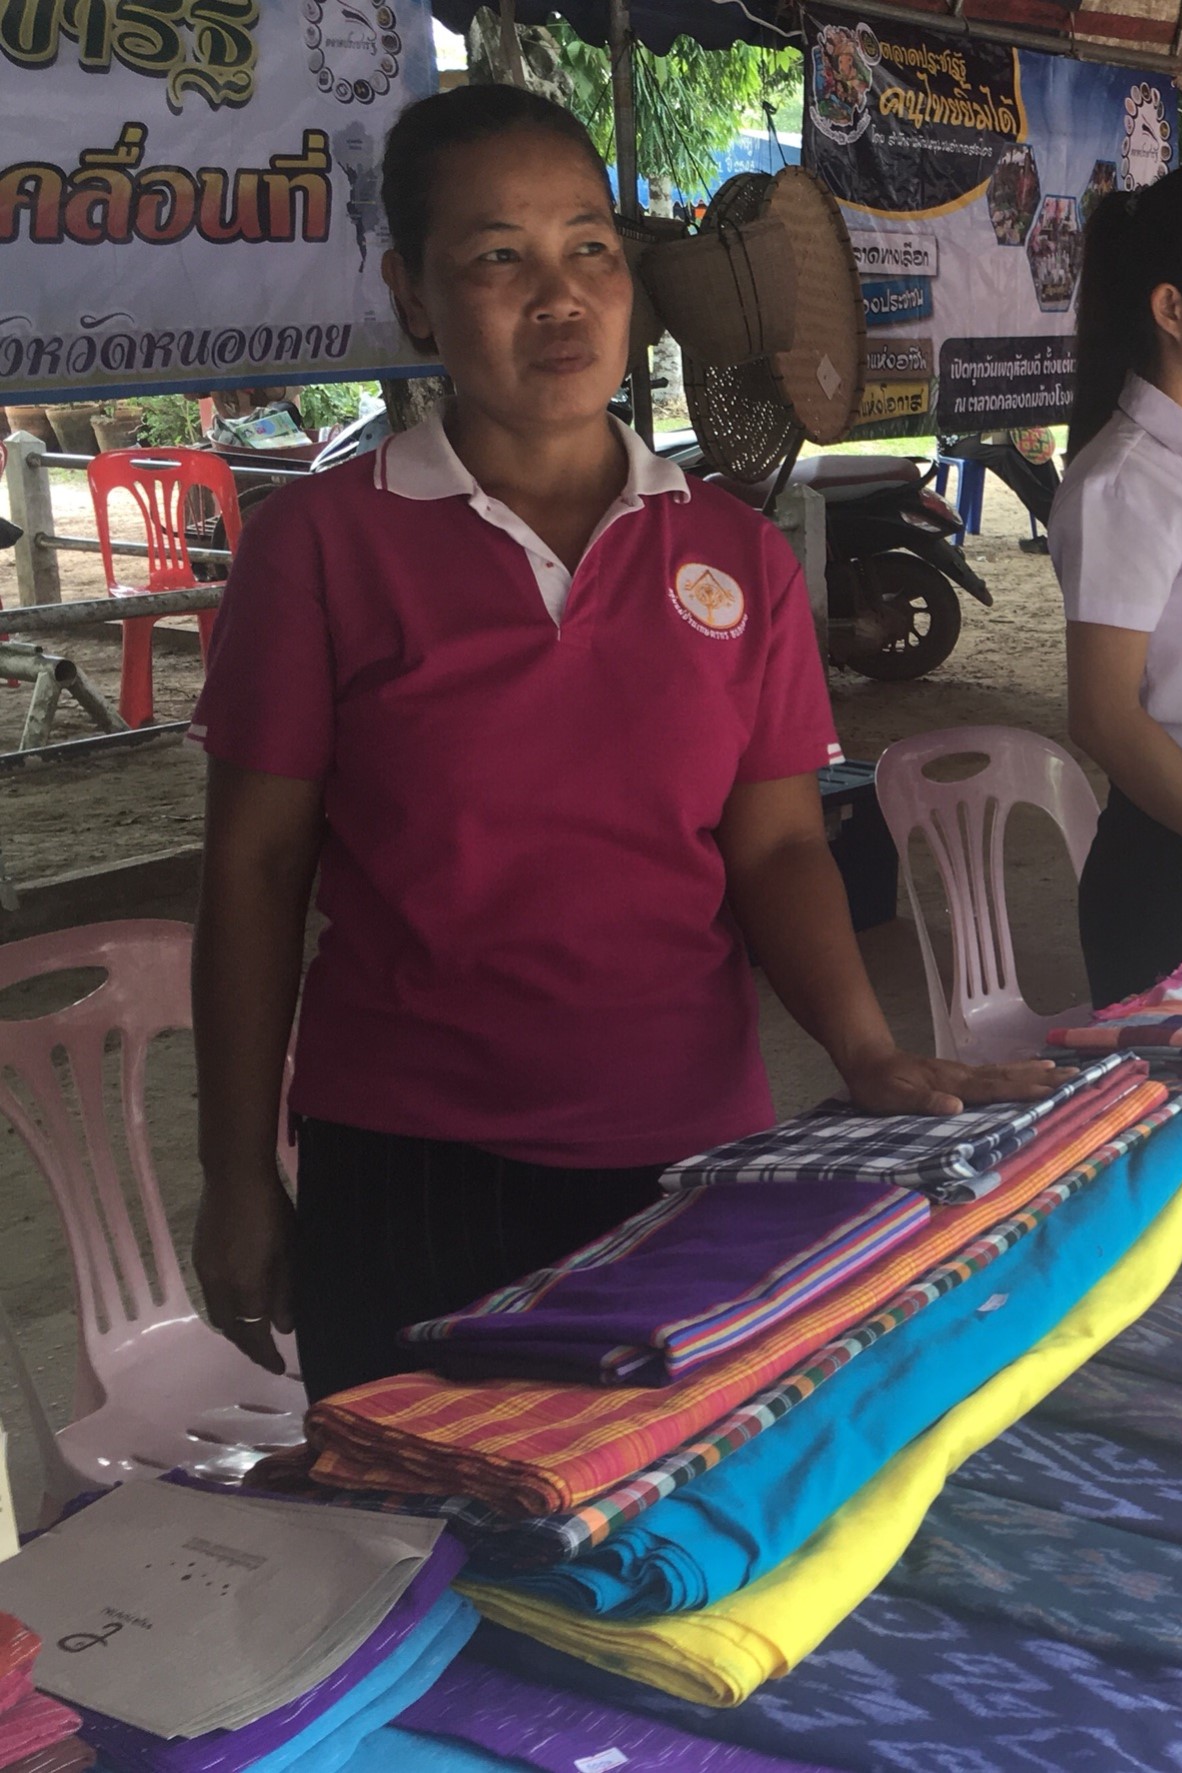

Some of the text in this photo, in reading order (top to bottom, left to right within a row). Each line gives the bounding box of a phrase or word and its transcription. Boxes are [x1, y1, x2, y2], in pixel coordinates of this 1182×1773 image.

[879, 41, 967, 82] ตลาดประชารัฐ
[879, 71, 1018, 136] คนไทยยิ้มได้
[0, 122, 332, 245] คลื่อนที่
[950, 353, 1041, 386] เปิดทุกวันพฤหัสบดี
[858, 382, 924, 418] แห่งโอกาส
[954, 383, 1074, 413] ณ ตลาดคลองถมข้างโรง
